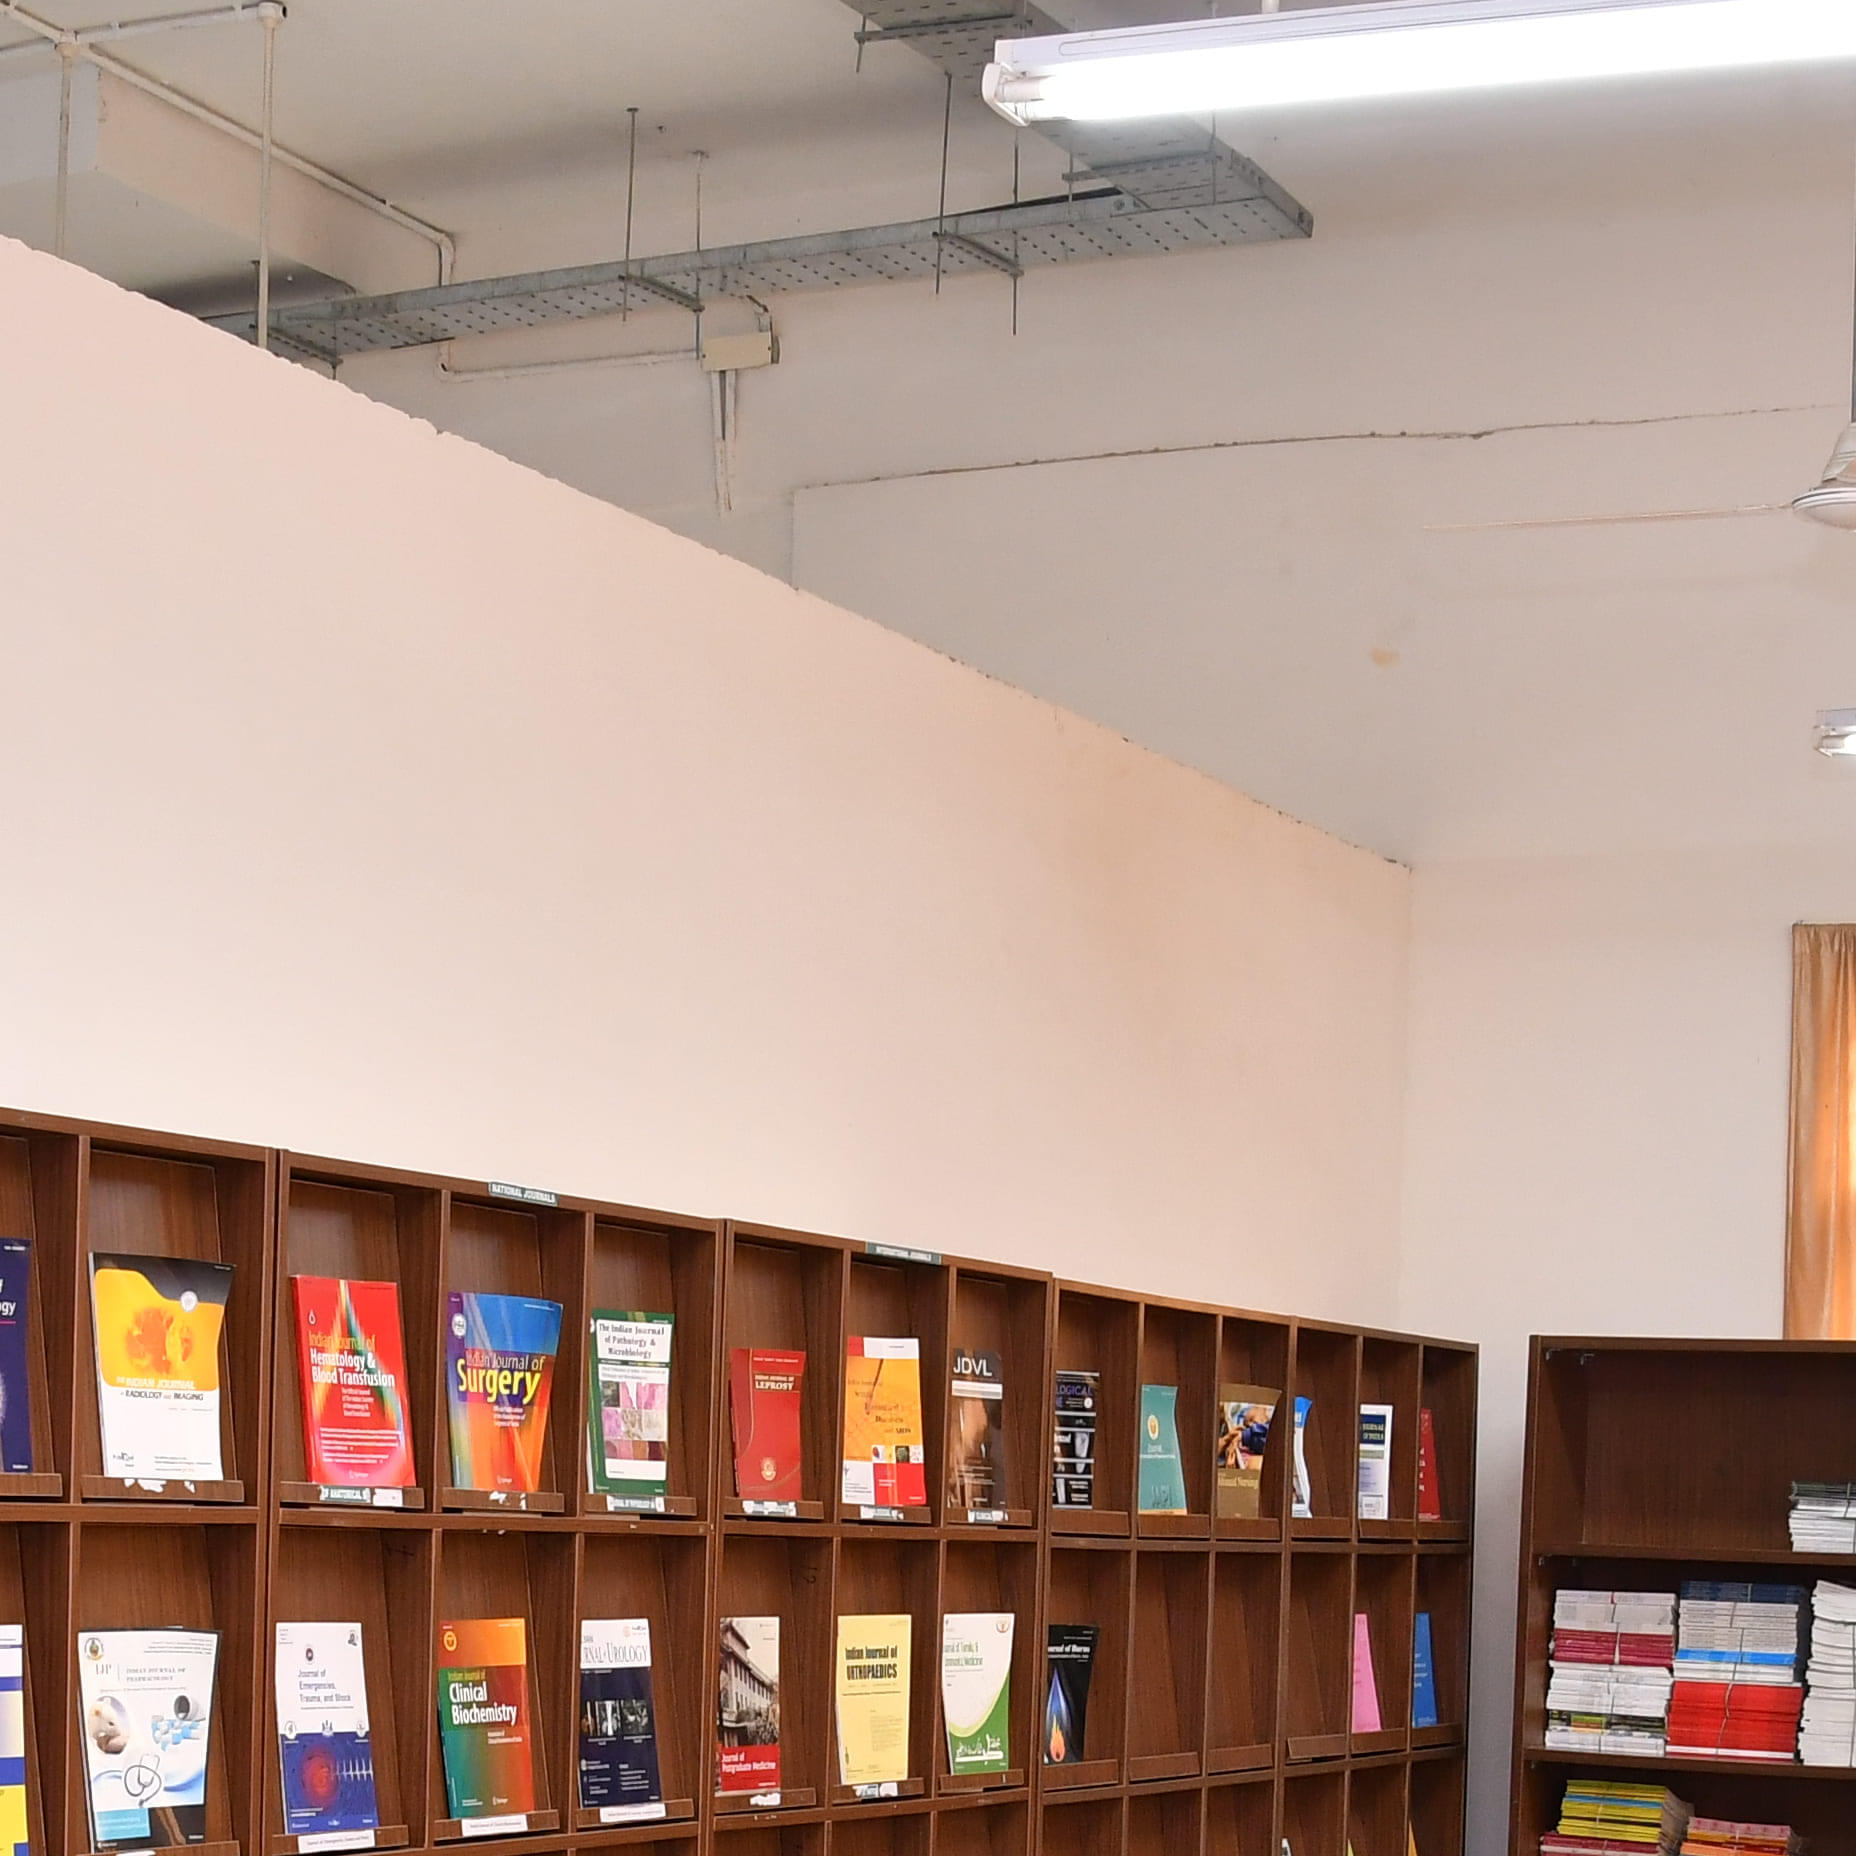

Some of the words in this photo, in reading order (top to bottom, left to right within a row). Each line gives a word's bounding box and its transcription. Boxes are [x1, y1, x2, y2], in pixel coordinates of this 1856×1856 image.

[492, 1183, 522, 1197] NATIONAL
[523, 1188, 556, 1202] JOURNALS
[600, 1324, 610, 1332] The
[612, 1324, 632, 1334] Indian
[635, 1326, 664, 1335] Journal
[612, 1336, 646, 1348] Pathology
[650, 1338, 656, 1346] &
[310, 1348, 364, 1371] Hematology
[367, 1352, 376, 1368] &
[466, 1350, 490, 1367] Indian
[492, 1352, 528, 1370] Journal
[532, 1356, 546, 1370] of
[608, 1348, 652, 1359] Microbiology
[954, 1357, 992, 1376] JDVL
[312, 1366, 338, 1384] Blood
[338, 1368, 395, 1386] Transfusion
[458, 1358, 541, 1404] Surgery
[756, 1381, 794, 1390] LEPROSY
[126, 1390, 162, 1399] RADIOLOGY
[846, 1648, 864, 1660] Indian
[866, 1646, 889, 1660] Journal
[890, 1645, 898, 1658] of
[298, 1670, 320, 1678] Journal
[320, 1669, 326, 1678] of
[847, 1664, 898, 1680] ORTHOPAEDICS
[300, 1680, 336, 1692] Emergencies,
[449, 1682, 488, 1702] Clinical
[451, 1702, 517, 1726] Biochemistry
[722, 1754, 738, 1763] Journal
[740, 1752, 744, 1761] of
[722, 1762, 752, 1774] Postgraduate
[753, 1761, 776, 1770] Medicine
